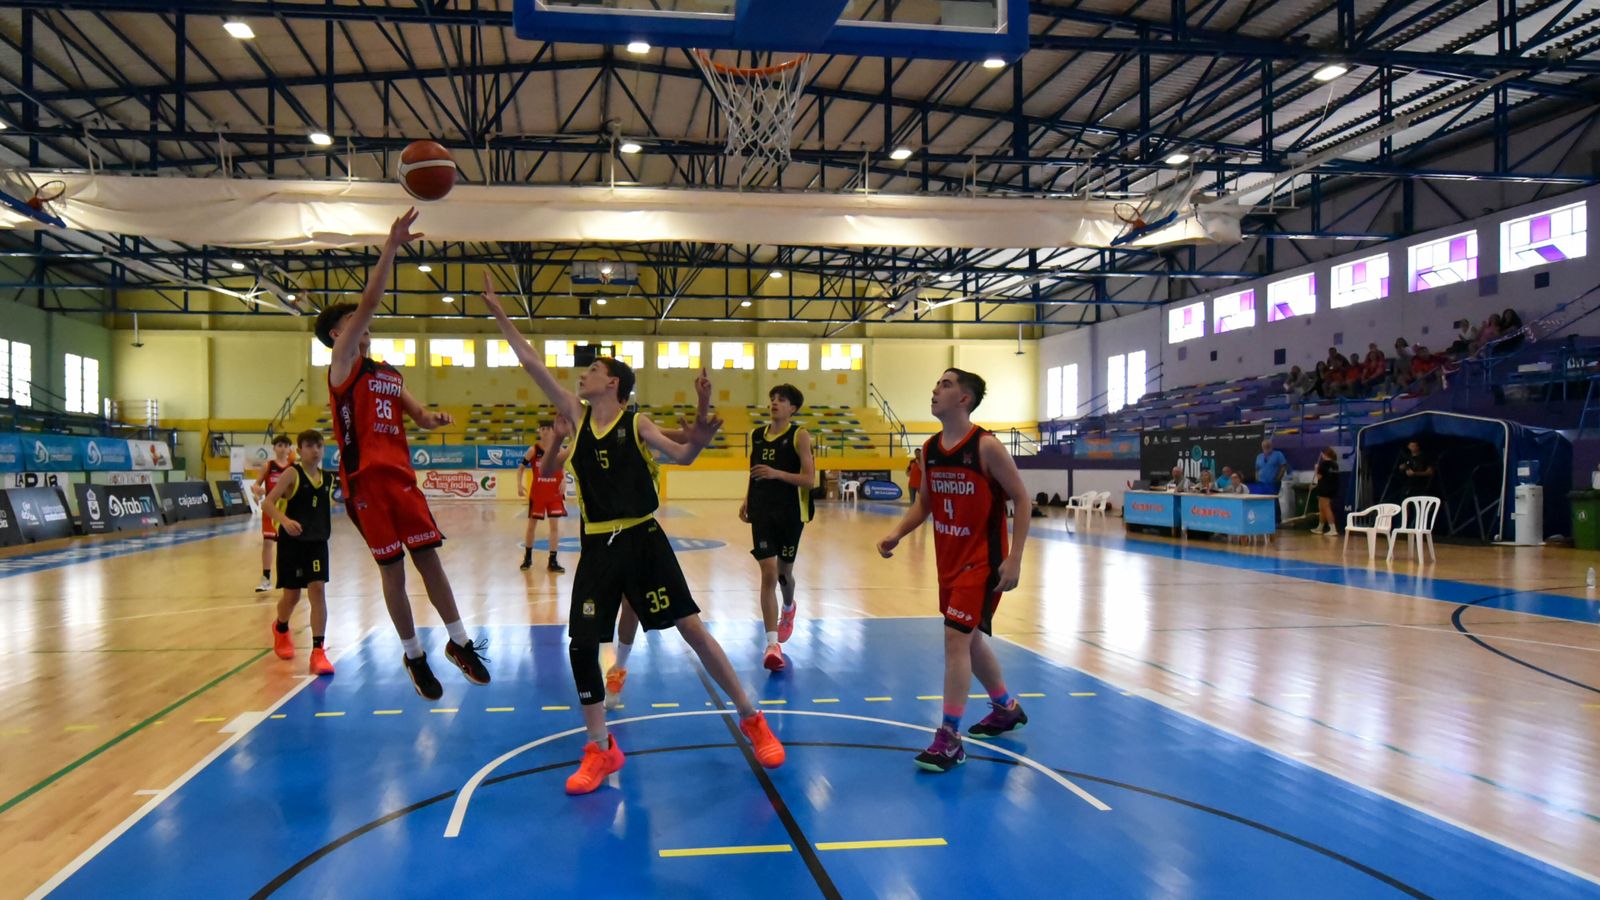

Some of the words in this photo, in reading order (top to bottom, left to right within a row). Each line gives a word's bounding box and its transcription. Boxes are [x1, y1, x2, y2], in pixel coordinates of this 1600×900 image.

[375, 398, 393, 420] 26
[374, 421, 400, 436] ULEVA
[762, 448, 775, 460] 22
[178, 494, 203, 509] cajasur
[312, 496, 318, 508] 8
[943, 498, 954, 520] 4
[781, 545, 795, 558] 22
[312, 559, 321, 573] 8
[646, 586, 670, 614] 35
